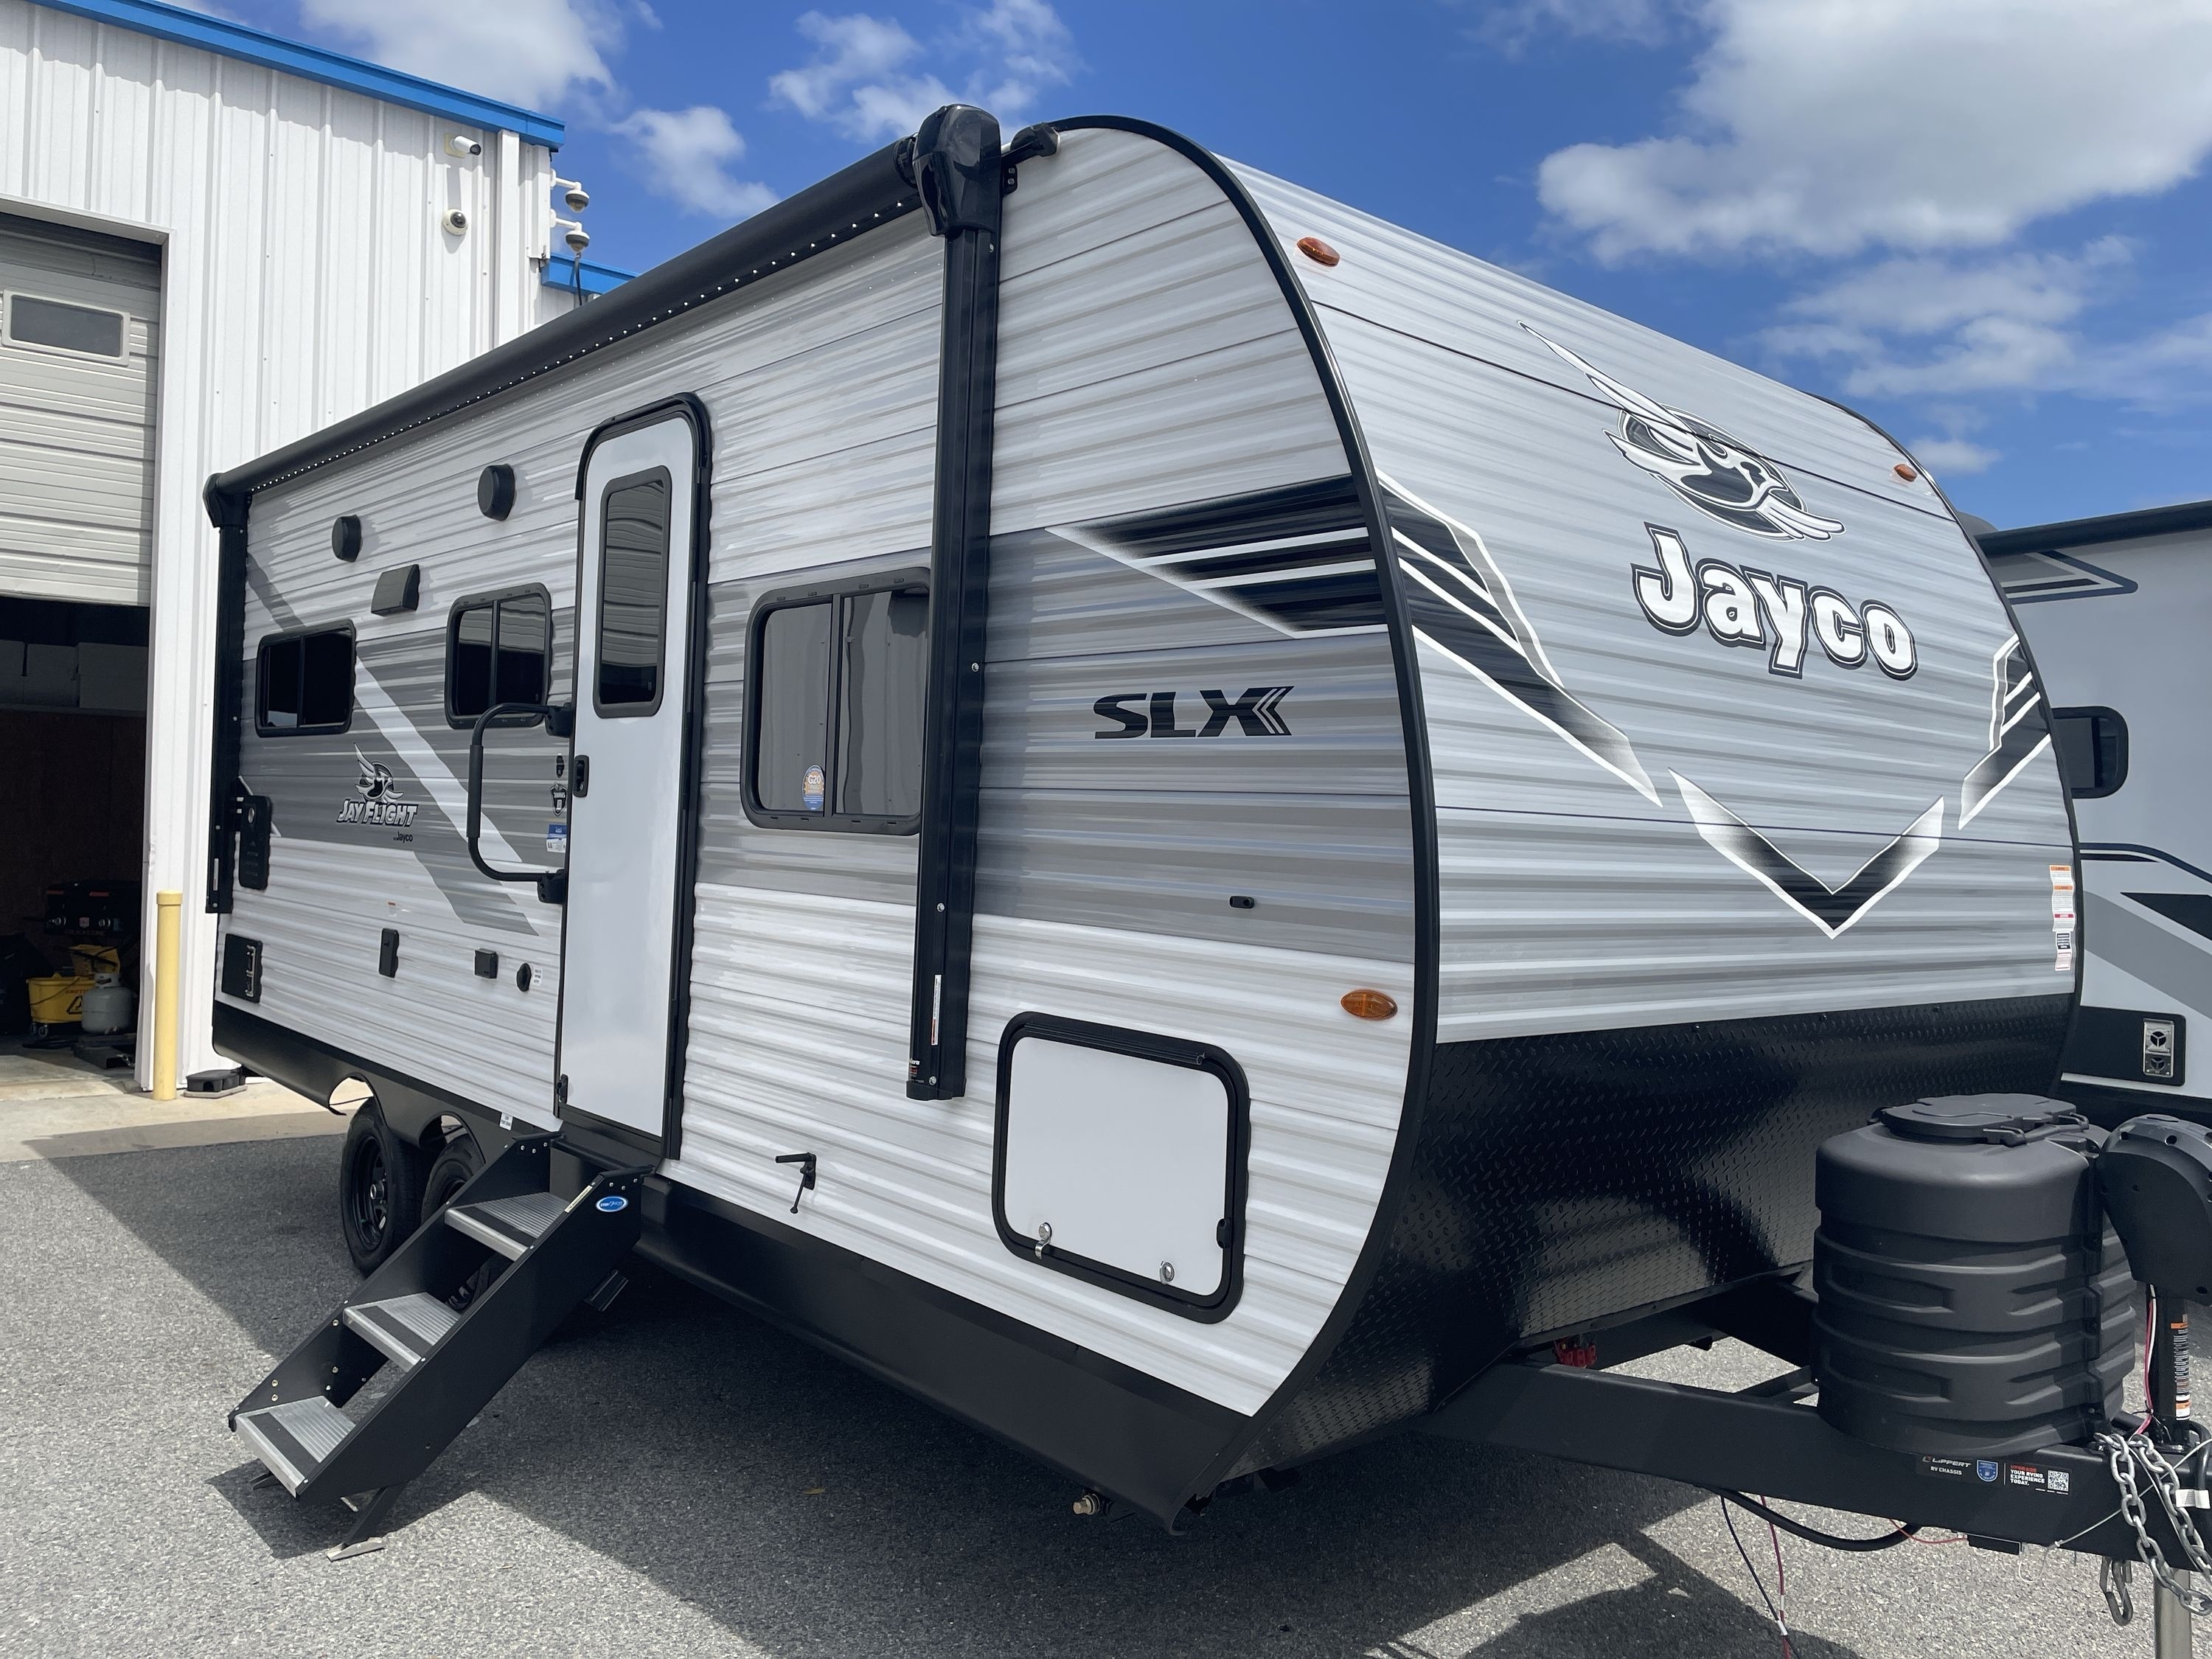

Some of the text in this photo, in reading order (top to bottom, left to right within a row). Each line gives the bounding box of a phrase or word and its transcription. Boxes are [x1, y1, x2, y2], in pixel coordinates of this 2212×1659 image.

[1630, 521, 1918, 681] Jayco
[1093, 685, 1295, 740] SLX
[808, 775, 821, 785] G20
[337, 799, 418, 827] JAY FLIGHT
[397, 831, 413, 844] Jayco
[1938, 1467, 1963, 1475] CHASSIS
[2010, 1474, 2045, 1484] EXPERIENCE
